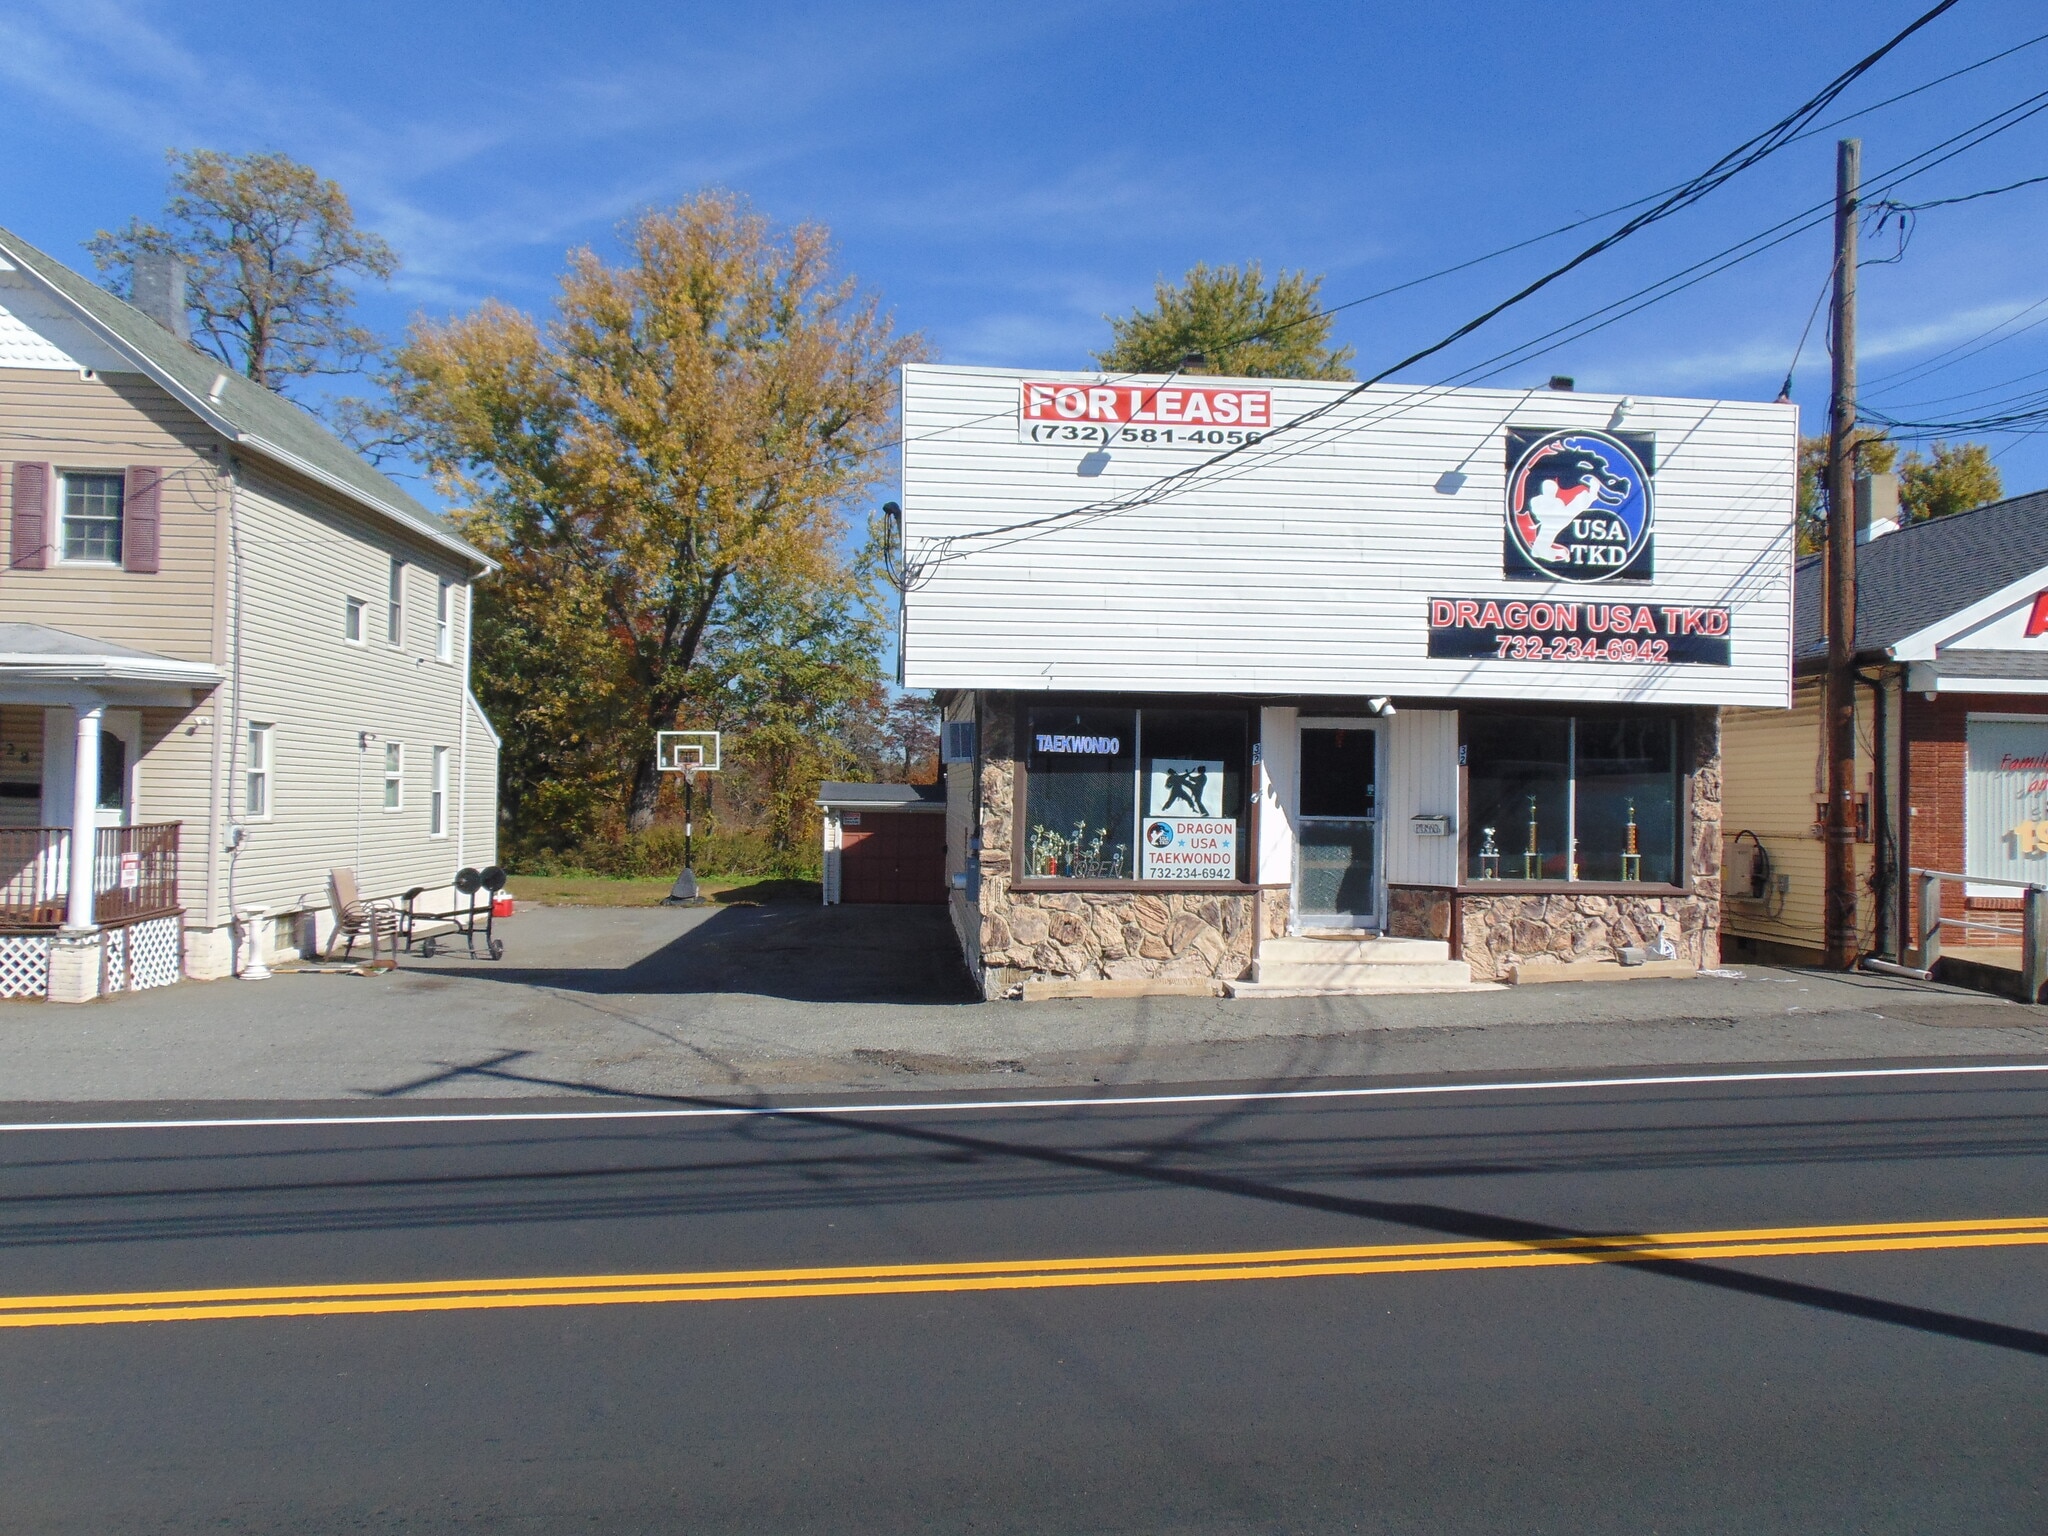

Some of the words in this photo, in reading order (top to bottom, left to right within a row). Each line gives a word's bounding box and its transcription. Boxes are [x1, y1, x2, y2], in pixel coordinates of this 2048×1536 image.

[1029, 386, 1118, 419] FOR
[1130, 390, 1267, 424] LEASE
[1030, 424, 1110, 444] (732)
[1572, 518, 1626, 541] USA
[1570, 545, 1627, 566] TKD
[1431, 599, 1578, 631] DRAGON
[1587, 605, 1656, 633] USA
[1661, 607, 1729, 635] TKD
[1496, 635, 1669, 663] 732-234-6942
[1036, 734, 1120, 755] TAEKWONDO
[1177, 823, 1233, 835] DRAGON
[1191, 838, 1218, 849] USA
[1149, 852, 1231, 865] TAEKWONDO
[1149, 867, 1231, 879] 732-234-6942
